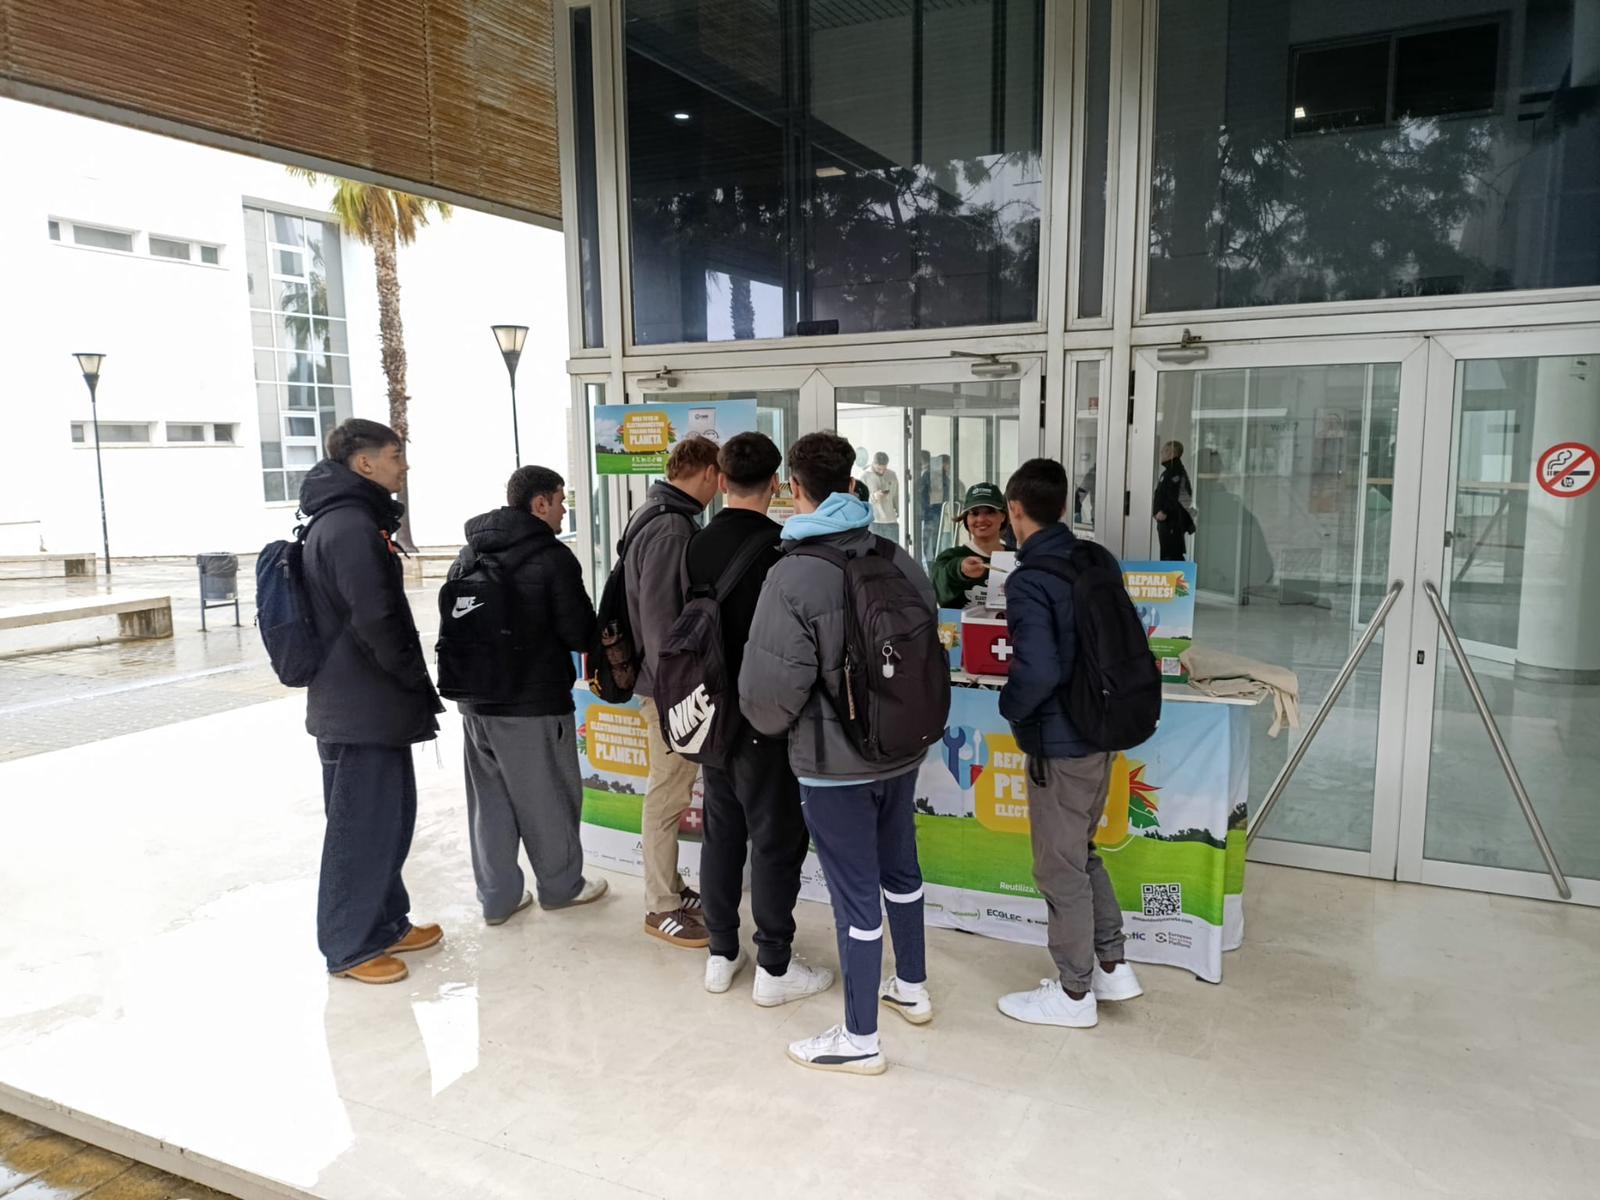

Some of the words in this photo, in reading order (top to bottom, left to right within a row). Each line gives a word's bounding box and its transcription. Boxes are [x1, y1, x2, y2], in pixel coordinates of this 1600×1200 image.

[456, 596, 476, 609] NIKE
[669, 683, 715, 741] NIKE
[596, 743, 647, 766] PLANETA
